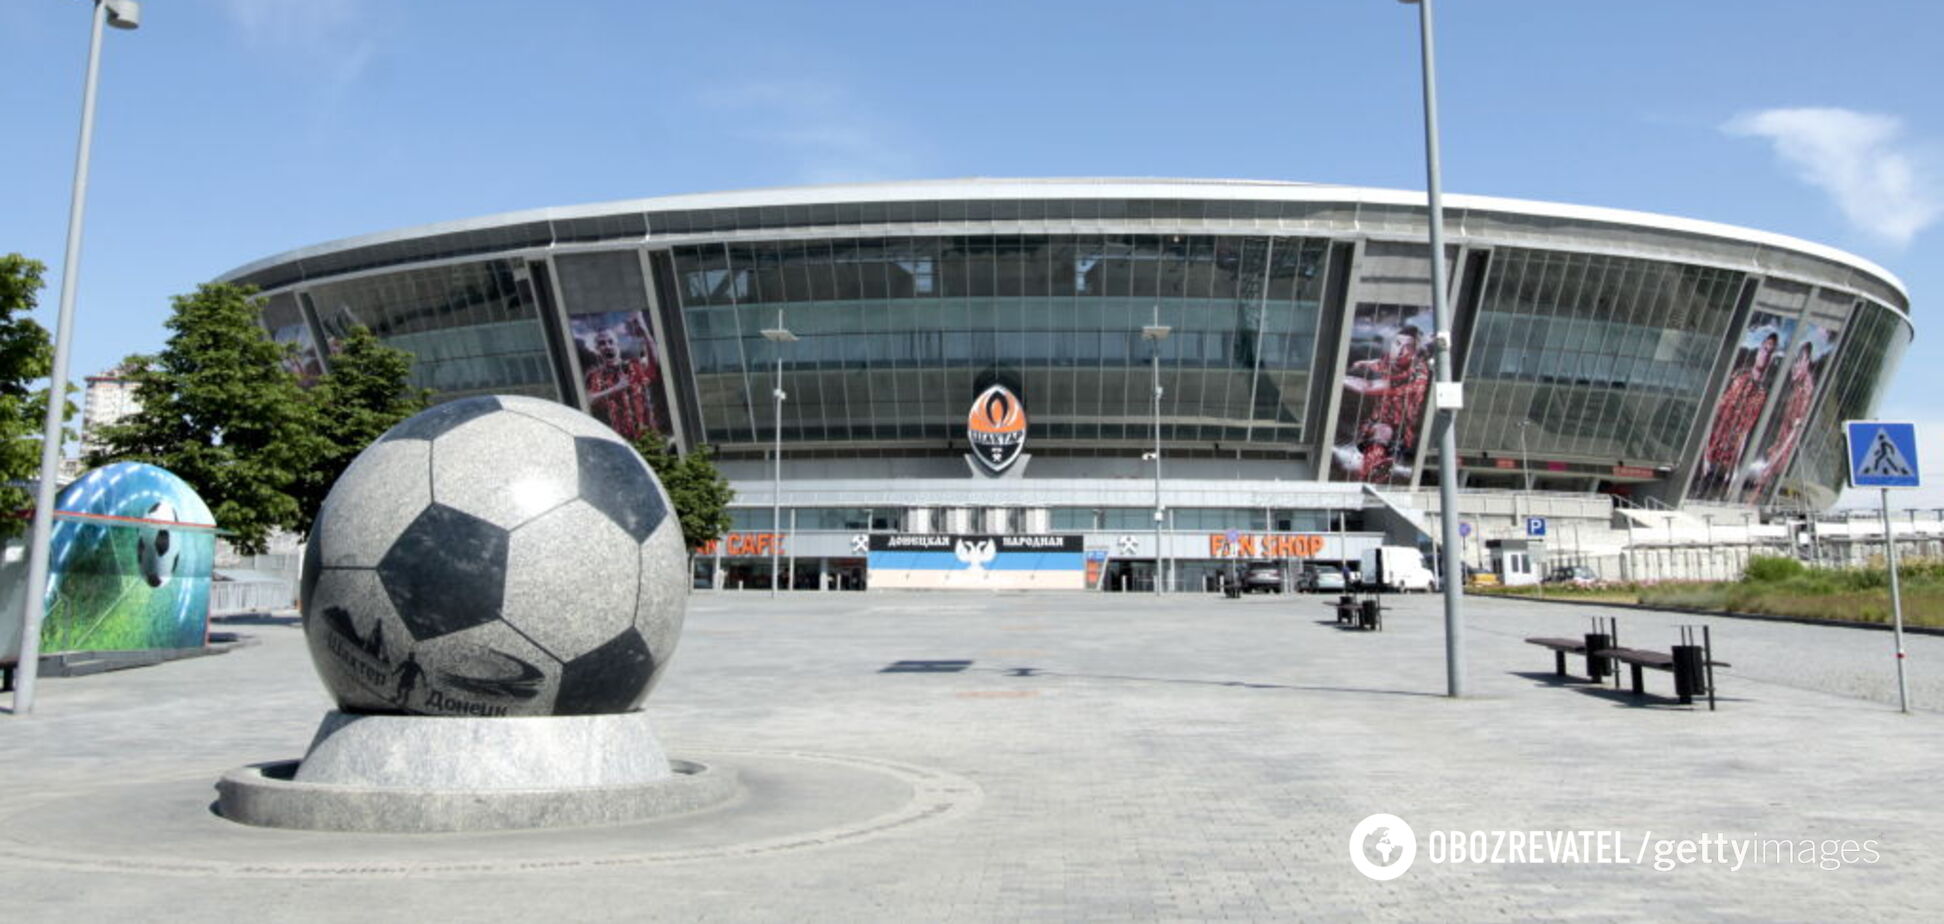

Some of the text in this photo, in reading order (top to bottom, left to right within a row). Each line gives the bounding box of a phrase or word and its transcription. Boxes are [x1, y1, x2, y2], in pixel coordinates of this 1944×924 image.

[1531, 519, 1542, 535] P
[726, 532, 785, 555] CAFE
[887, 536, 1064, 548] ДОНЕЦКАЯ НАРОДНАЯ
[1262, 534, 1324, 556] SHOP
